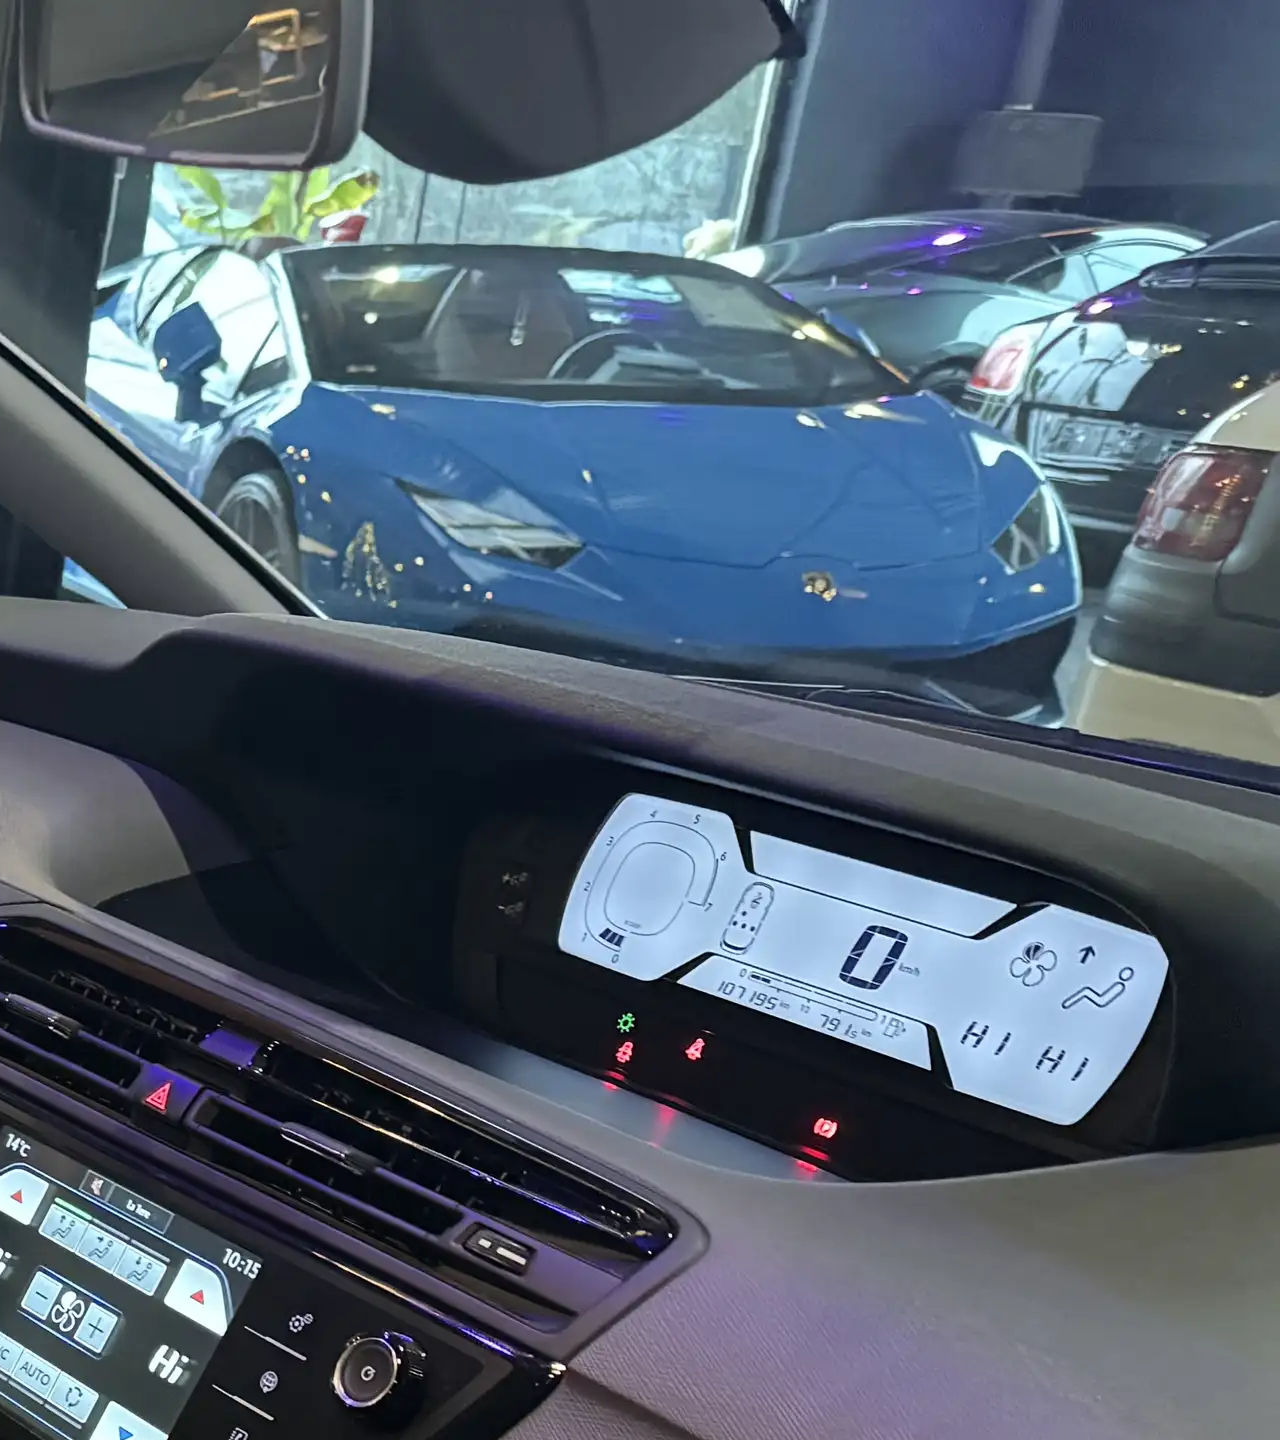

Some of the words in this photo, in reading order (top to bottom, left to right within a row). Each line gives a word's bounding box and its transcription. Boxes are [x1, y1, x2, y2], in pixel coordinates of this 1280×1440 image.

[693, 814, 701, 824] 5
[720, 851, 727, 861] 6
[611, 954, 620, 963] 0
[839, 925, 908, 990] 0
[960, 1021, 1011, 1056] HI
[1036, 1046, 1089, 1081] HI
[222, 1248, 262, 1280] 10:15
[20, 1361, 50, 1386] AUTO
[148, 1344, 189, 1384] Hi
